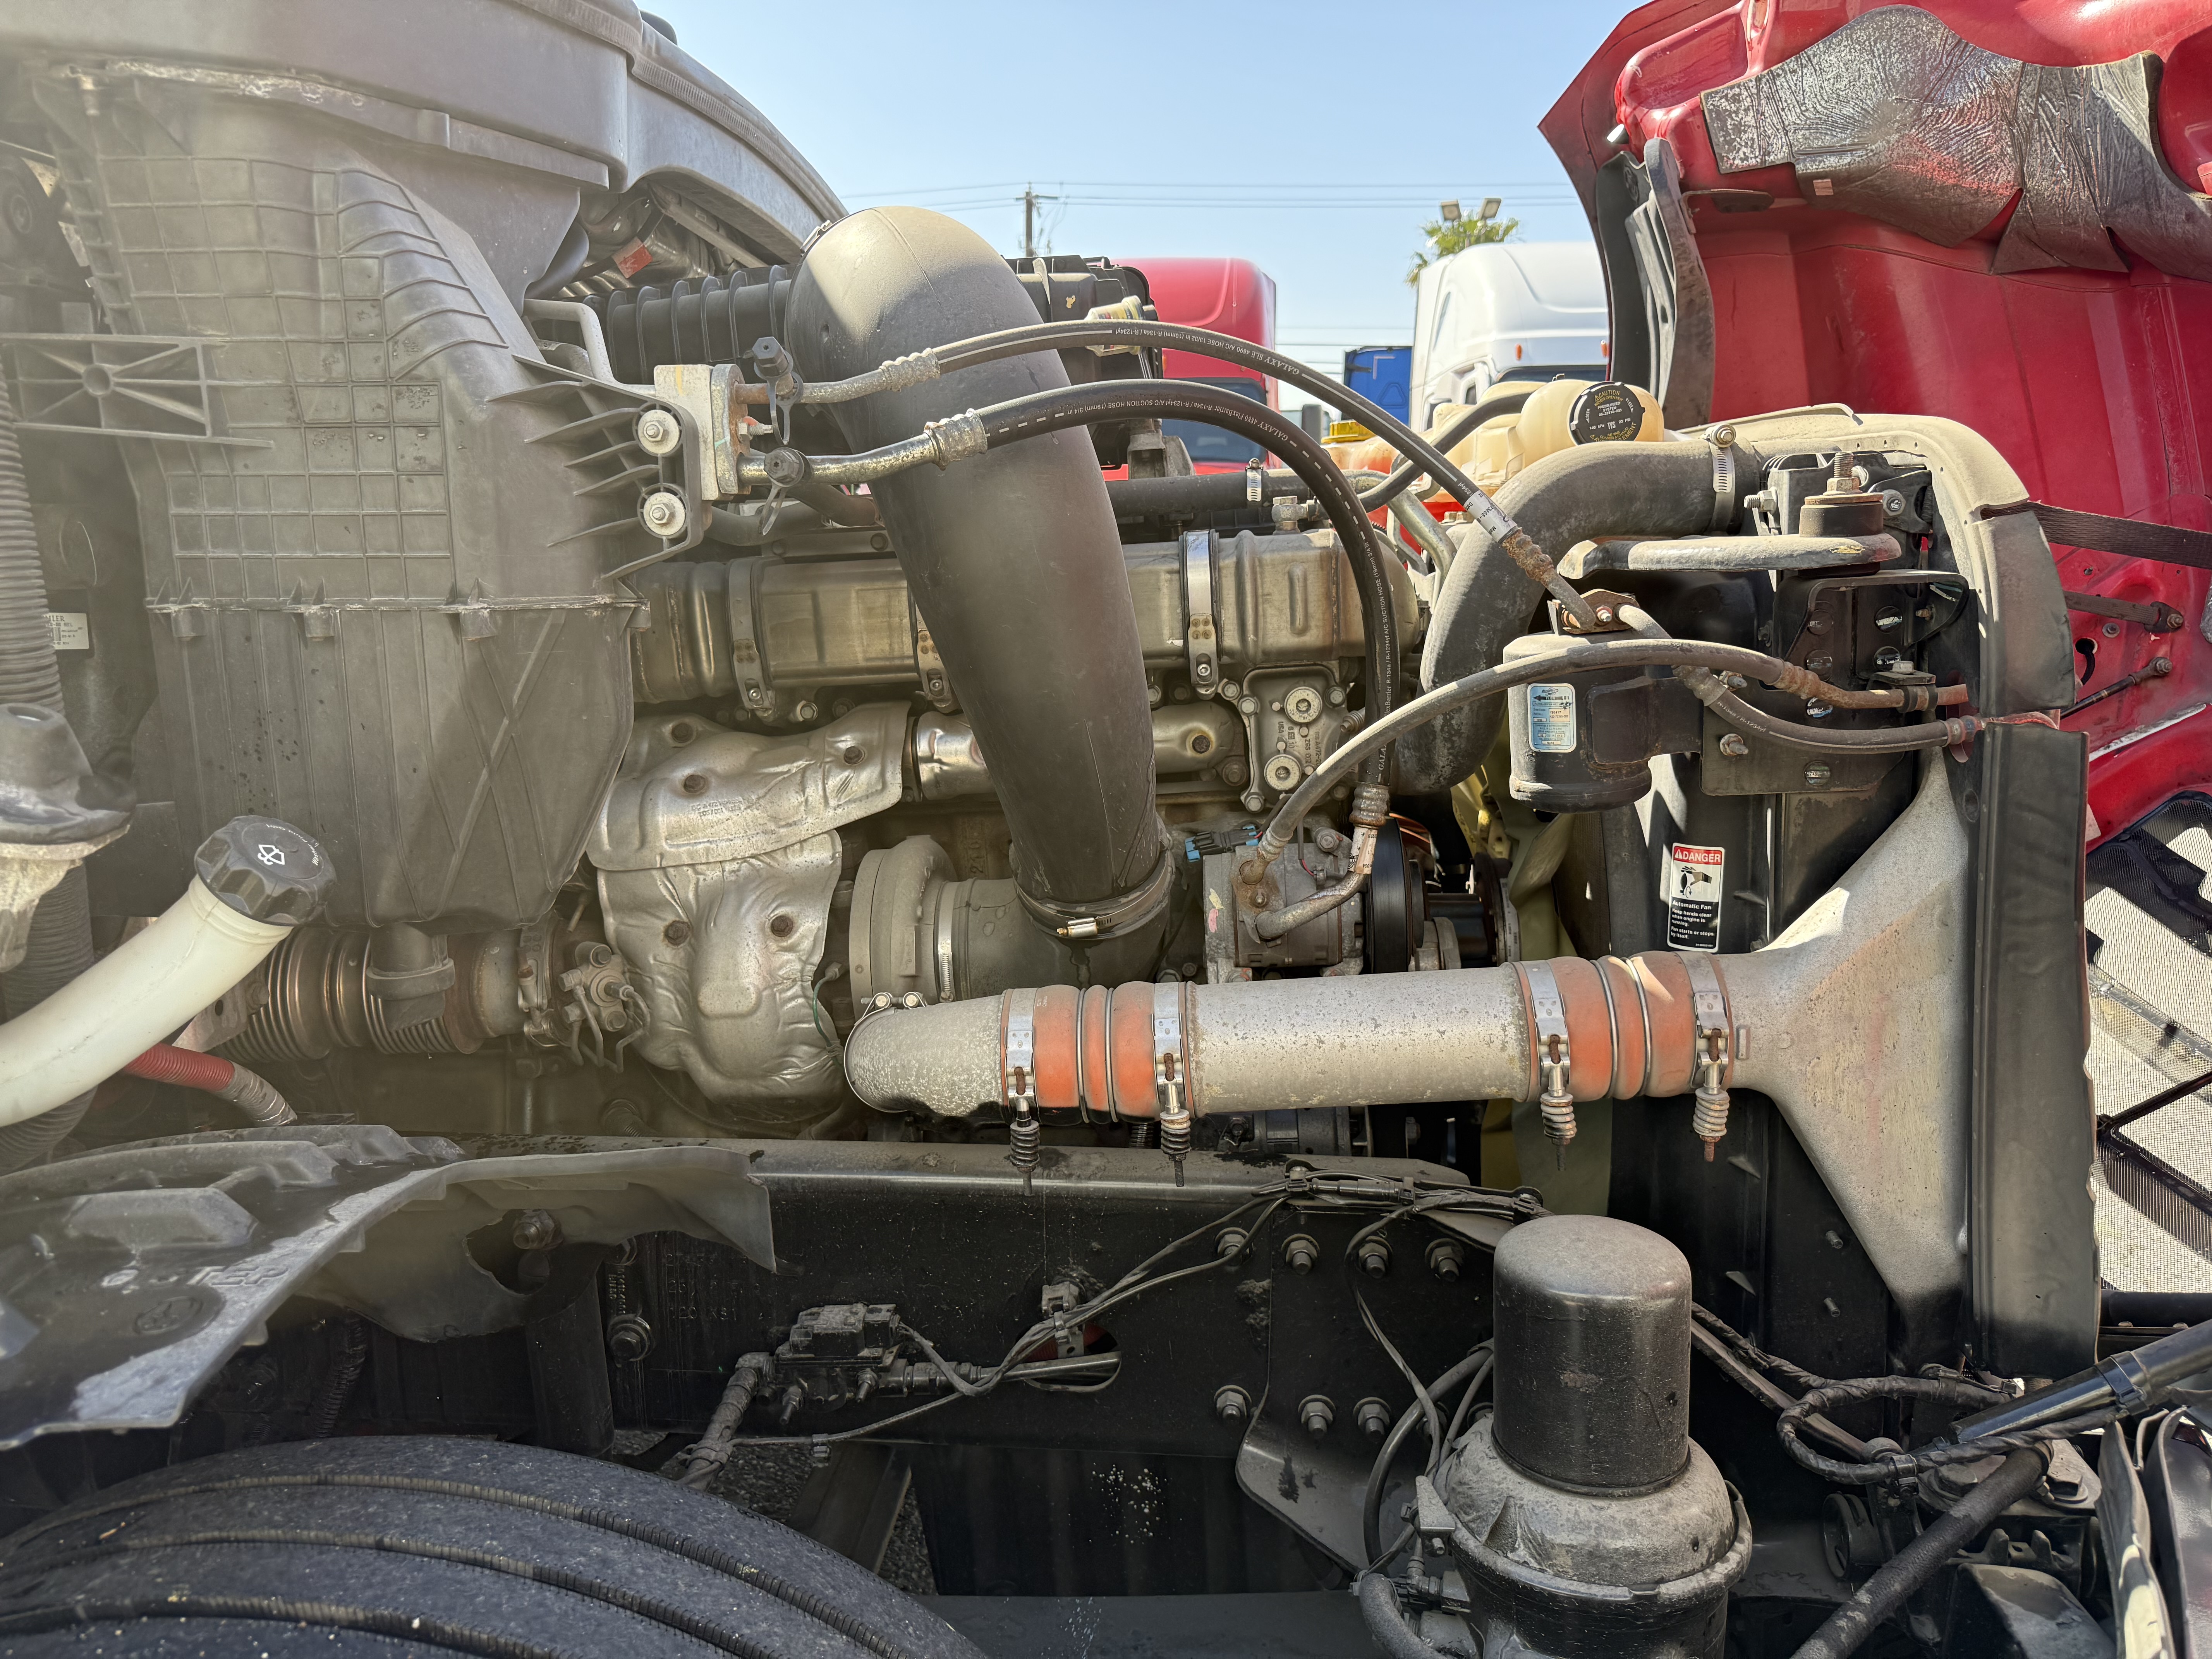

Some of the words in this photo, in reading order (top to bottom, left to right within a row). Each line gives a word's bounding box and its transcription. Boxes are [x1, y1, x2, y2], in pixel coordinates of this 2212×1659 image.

[1207, 339, 1224, 348] HOSE
[1251, 351, 1264, 360] SLE
[1264, 357, 1299, 375] GALAXY
[1599, 390, 1620, 399] CAUTION
[1085, 402, 1106, 412] (19mm)
[1597, 401, 1621, 409] PRESSURIZED
[1214, 405, 1244, 419] FlexBarrier
[1245, 415, 1257, 424] 4880
[1258, 421, 1288, 441] GALAXY
[1369, 557, 1380, 578] (19mm)
[1380, 597, 1388, 623] SUCTION
[1378, 744, 1387, 770] GALA
[1683, 851, 1721, 862] DANGER
[1673, 900, 1699, 909] Automatic
